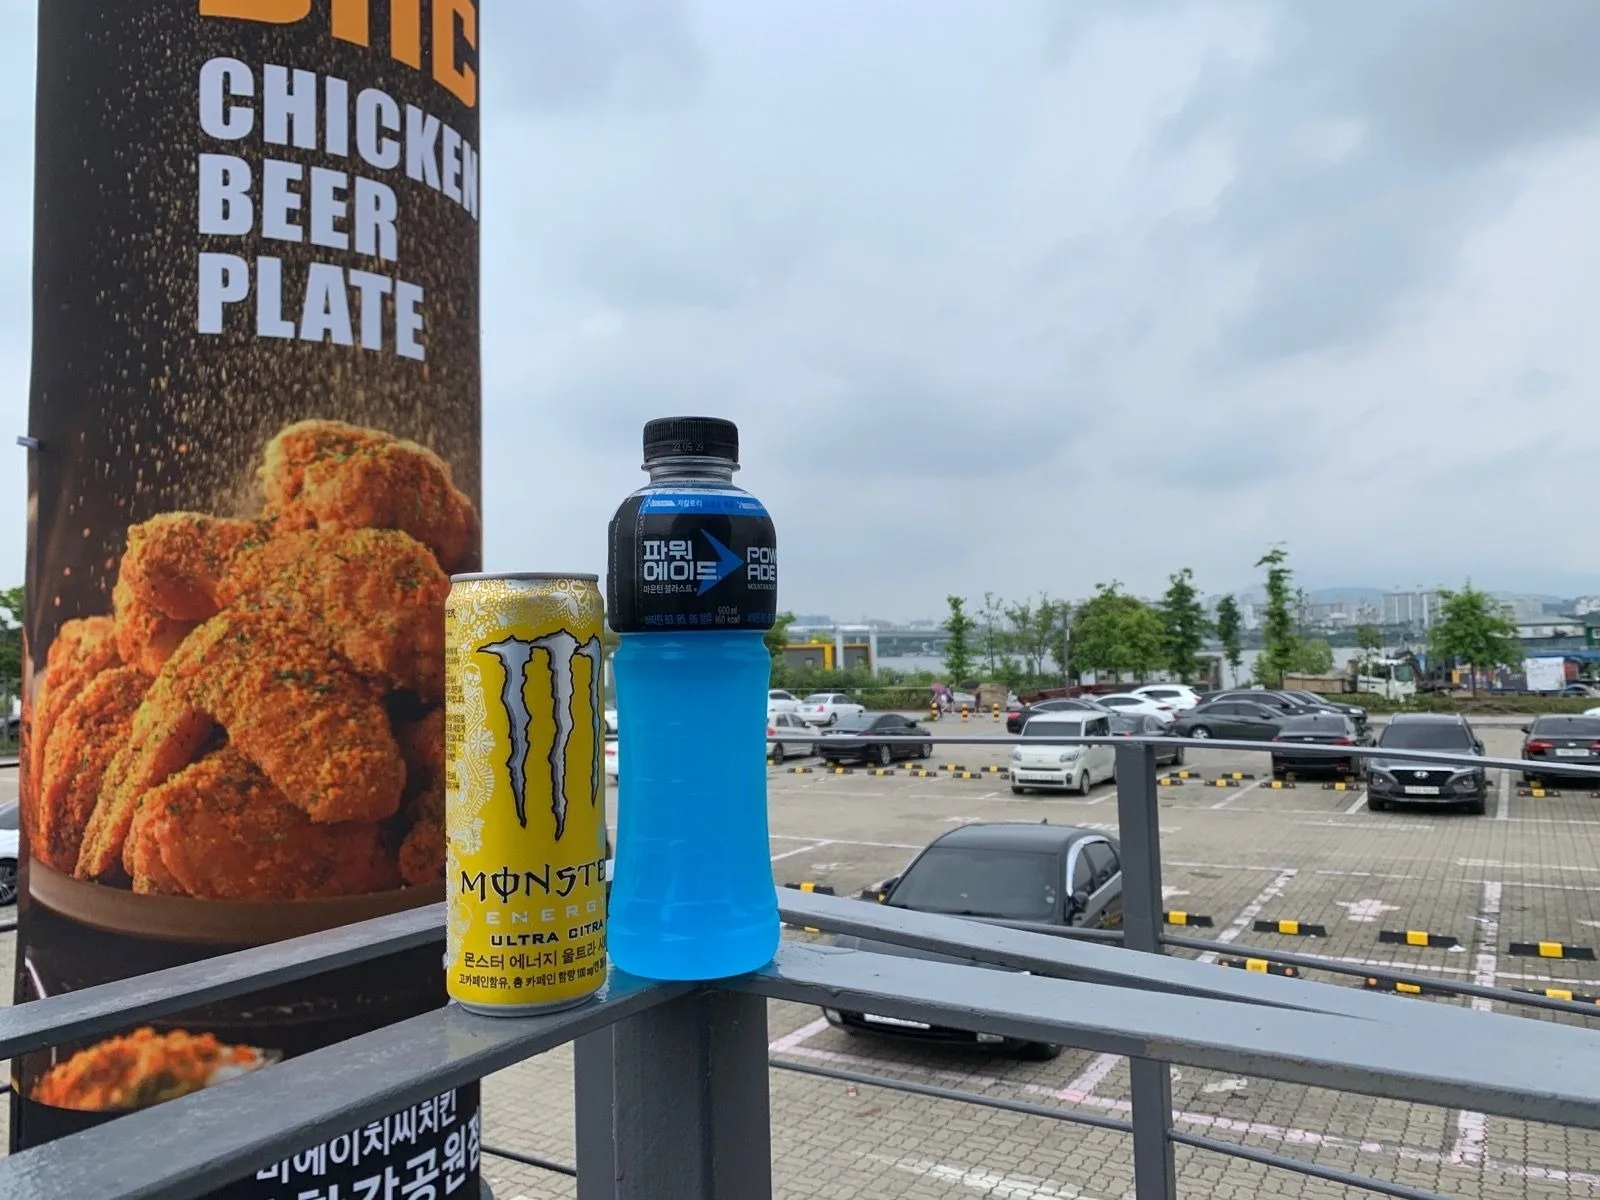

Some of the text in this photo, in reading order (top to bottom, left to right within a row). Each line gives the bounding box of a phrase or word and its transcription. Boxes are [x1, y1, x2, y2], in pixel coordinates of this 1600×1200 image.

[199, 56, 478, 221] CHICKEN
[199, 153, 398, 262] BEER
[198, 252, 425, 361] PLATE
[643, 540, 693, 560] 파워
[643, 560, 718, 581] 에이드
[748, 564, 776, 581] ADE
[643, 584, 664, 594] 마운틴
[491, 920, 604, 945] ULTRA CITRA
[464, 951, 505, 971] 몬스터
[509, 949, 557, 971] 에너지
[561, 939, 596, 965] 울트라
[459, 973, 511, 989] 고카페인함유,
[525, 972, 557, 989] 카페인
[268, 1106, 479, 1200] 강공원점
